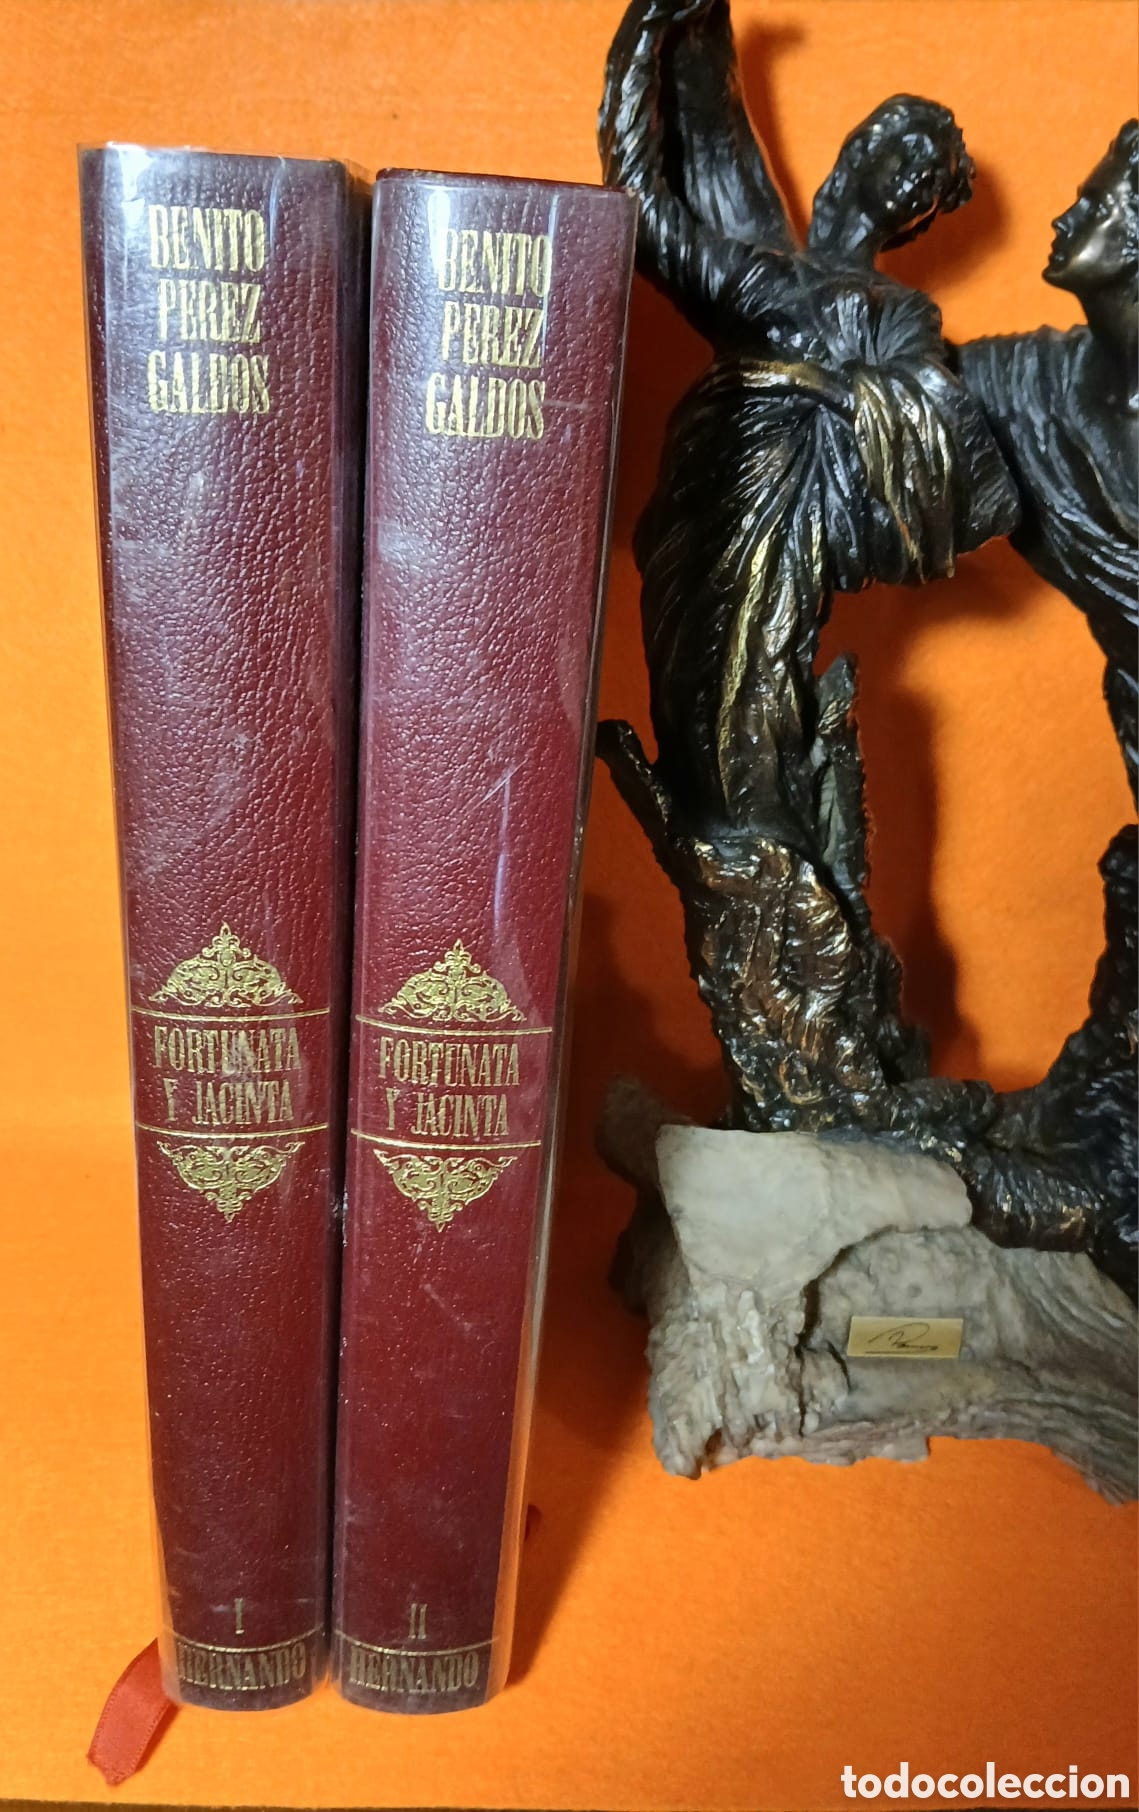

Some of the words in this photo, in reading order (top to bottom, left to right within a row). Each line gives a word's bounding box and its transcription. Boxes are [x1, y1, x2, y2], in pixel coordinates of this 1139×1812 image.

[148, 205, 266, 272] BENITO
[437, 229, 551, 297] BENITO
[158, 278, 262, 343] PEREZ
[442, 302, 543, 369] PEREZ
[147, 350, 270, 414] GALDOS
[425, 373, 545, 439] GALDOS
[154, 1026, 302, 1073] FORTUNATA
[379, 1036, 519, 1086] FORTUNATA
[163, 1078, 177, 1121] Y
[192, 1079, 294, 1126] JACINTA
[385, 1089, 400, 1130] Y
[410, 1092, 509, 1137] JACINTA
[234, 1598, 244, 1634] I
[408, 1603, 427, 1639] II
[177, 1641, 306, 1690] HERNANDO
[350, 1650, 479, 1693] HERNANDO
